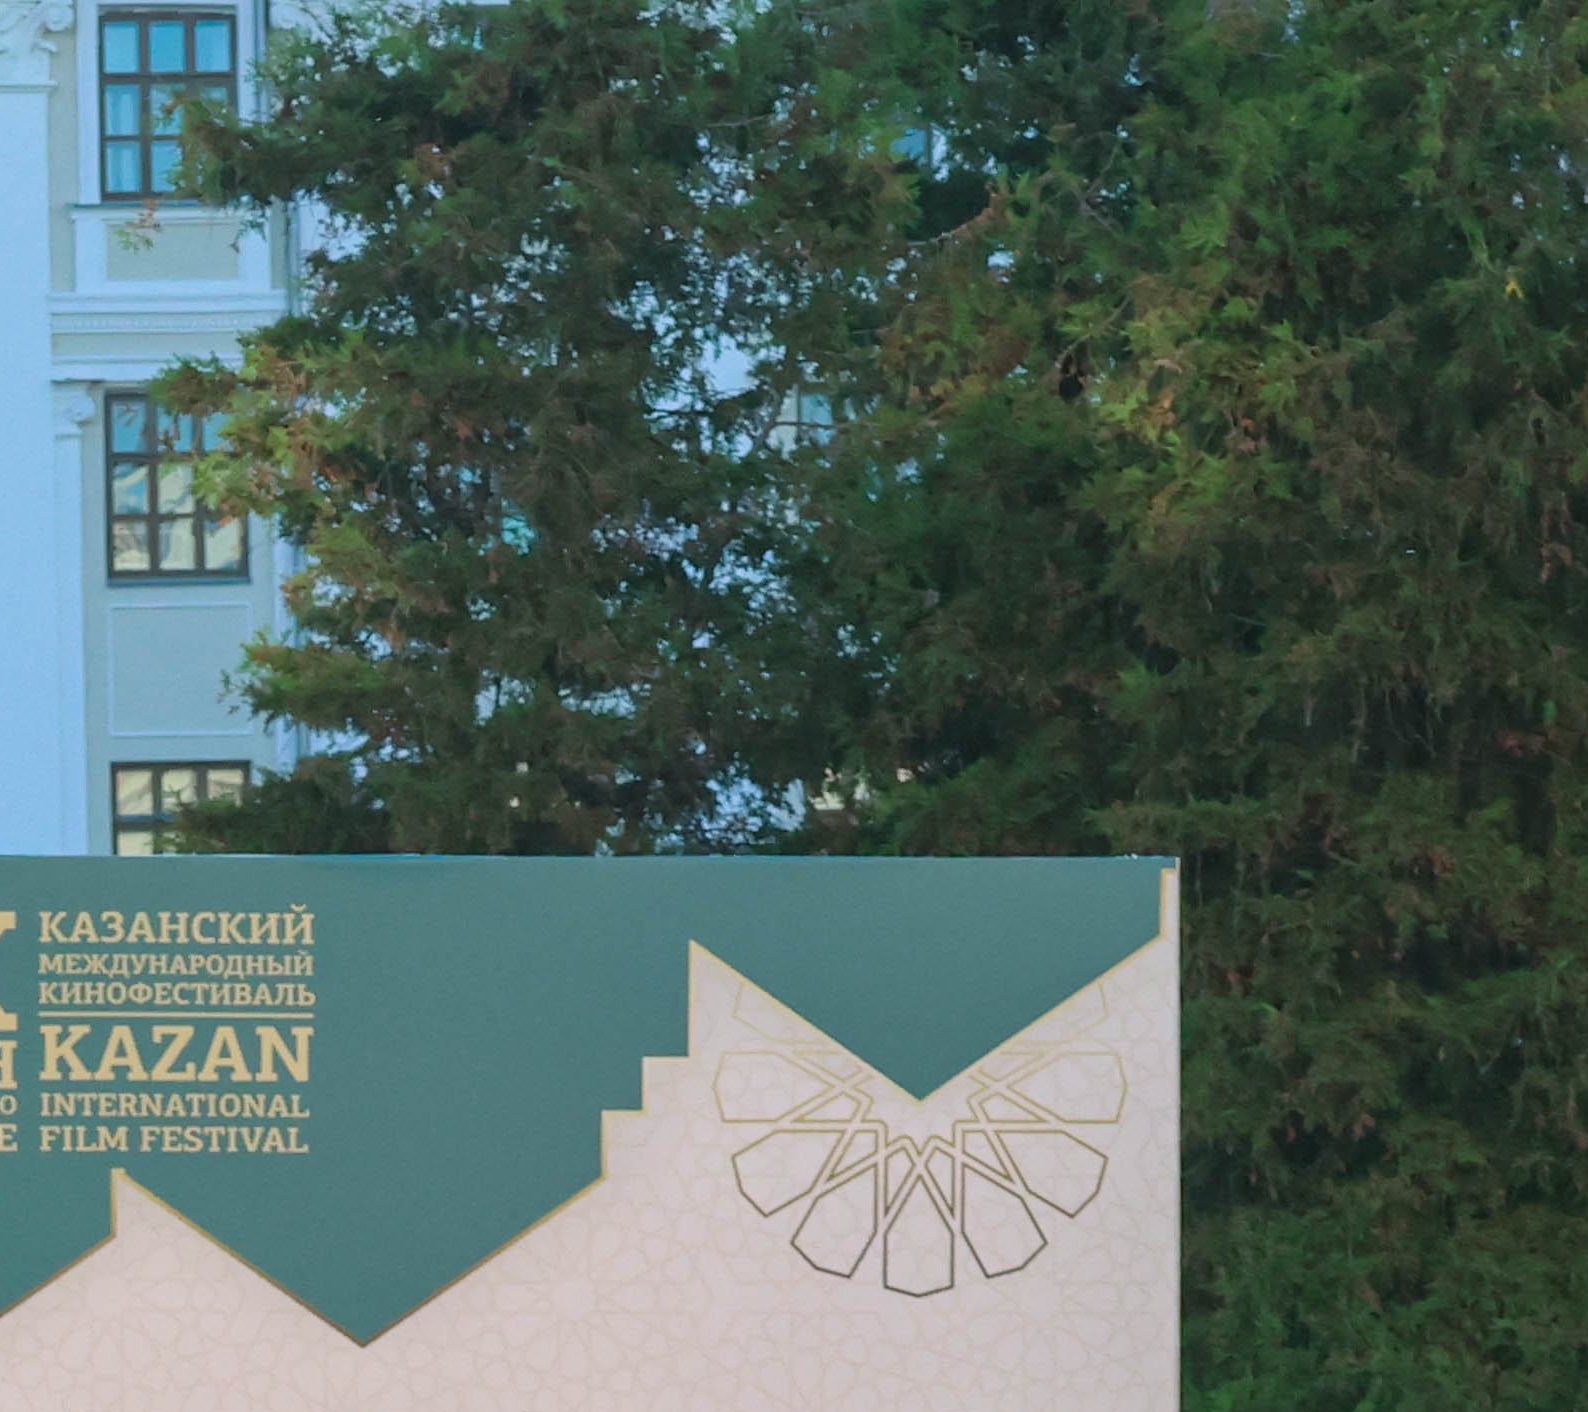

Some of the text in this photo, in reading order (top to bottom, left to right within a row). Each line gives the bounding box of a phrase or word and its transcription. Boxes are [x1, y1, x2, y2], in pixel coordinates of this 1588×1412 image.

[37, 904, 316, 945] КАЗАНСКИЙ
[37, 949, 315, 978] МЕЖДУНАРОДНЫЙ
[37, 981, 317, 1008] КИНОФЕСТИВАЛЬ
[37, 1024, 314, 1083] KAZAN
[39, 1091, 311, 1119] INTERNATIONAL
[39, 1125, 310, 1154] FILM FESTIVAL
